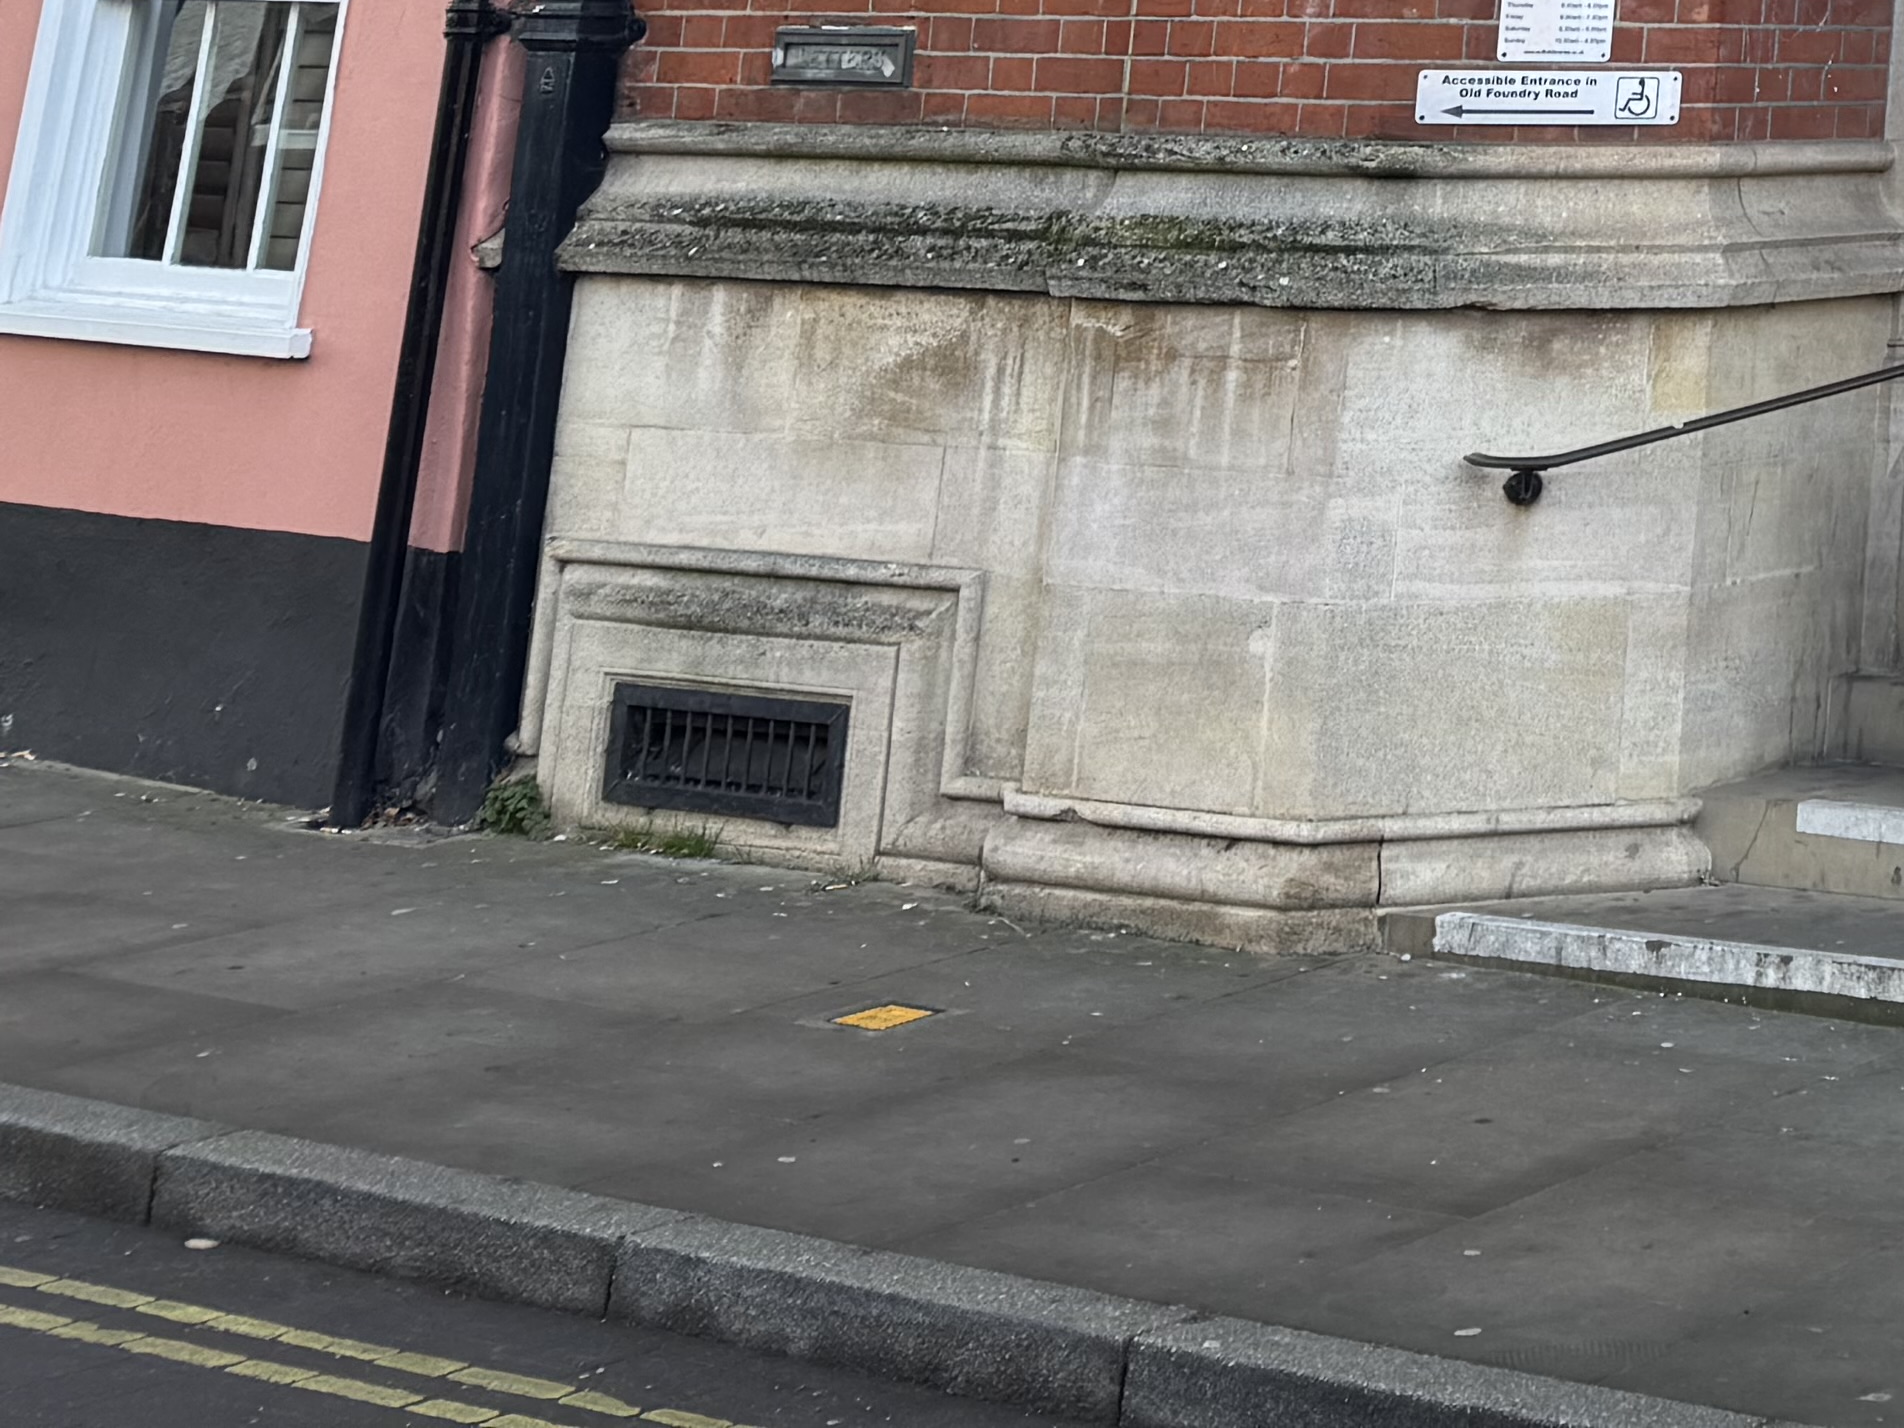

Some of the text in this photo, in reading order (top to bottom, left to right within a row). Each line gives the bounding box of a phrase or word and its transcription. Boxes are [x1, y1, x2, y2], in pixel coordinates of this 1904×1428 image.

[1442, 75, 1597, 86] Accessible Entrance in
[1459, 88, 1578, 100] Old Foundry Road
